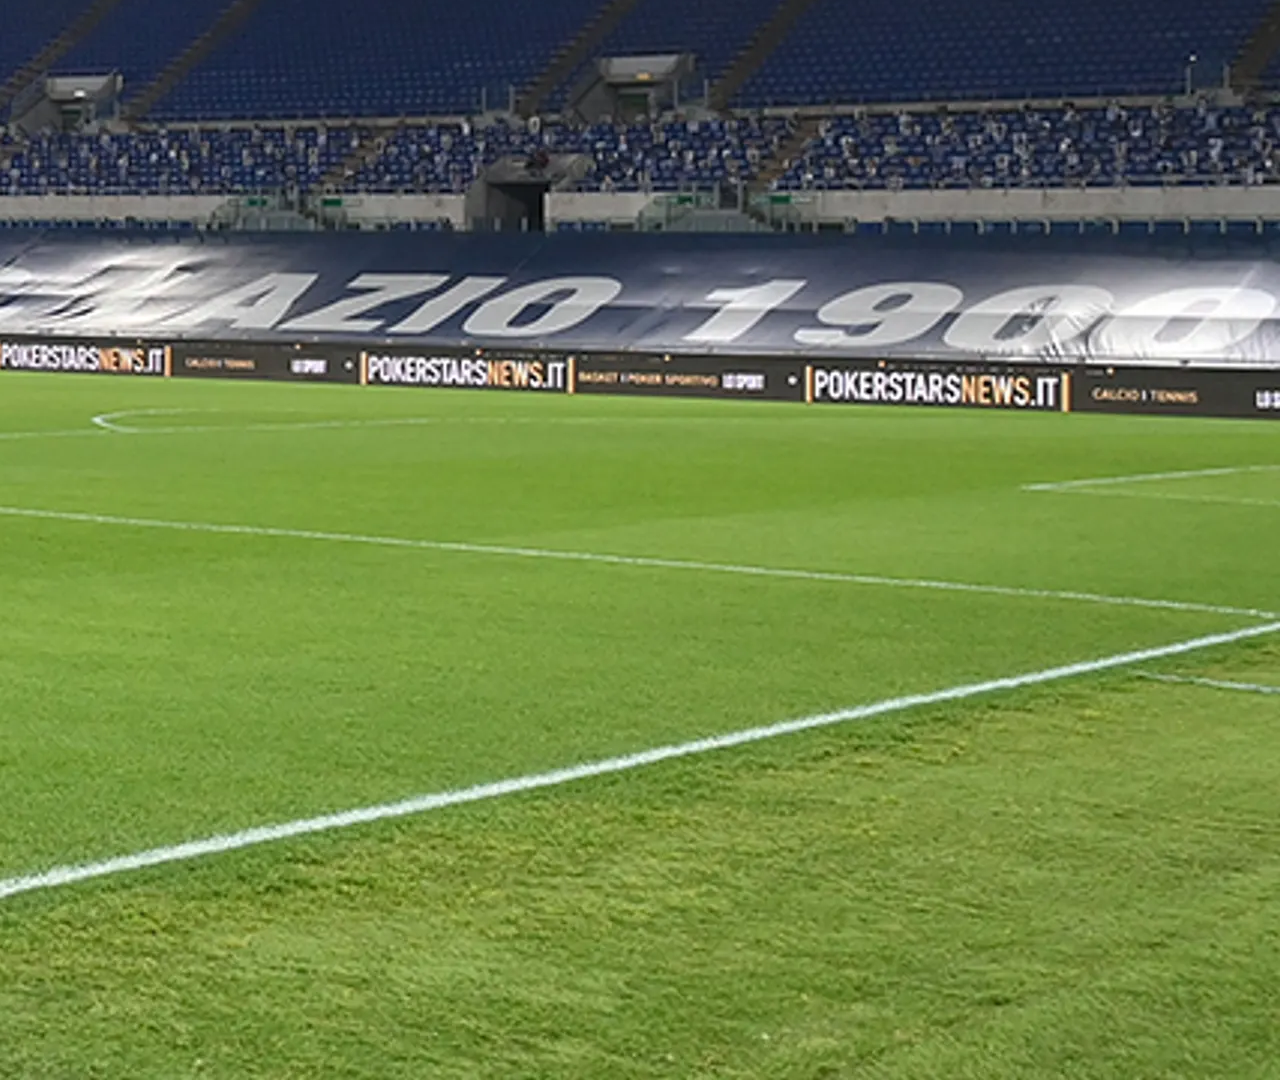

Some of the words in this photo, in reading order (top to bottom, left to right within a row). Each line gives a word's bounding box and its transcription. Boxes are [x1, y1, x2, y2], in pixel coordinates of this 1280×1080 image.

[681, 277, 1278, 354] 1900
[2, 342, 164, 373] POKERSTARSNEWS.IT
[369, 356, 565, 388] POKERSTARSNEWS.IT
[815, 370, 1059, 407] POKERSTARSNEWS.IT
[1092, 387, 1139, 402] CALCIO
[1150, 389, 1199, 404] TENNIS
